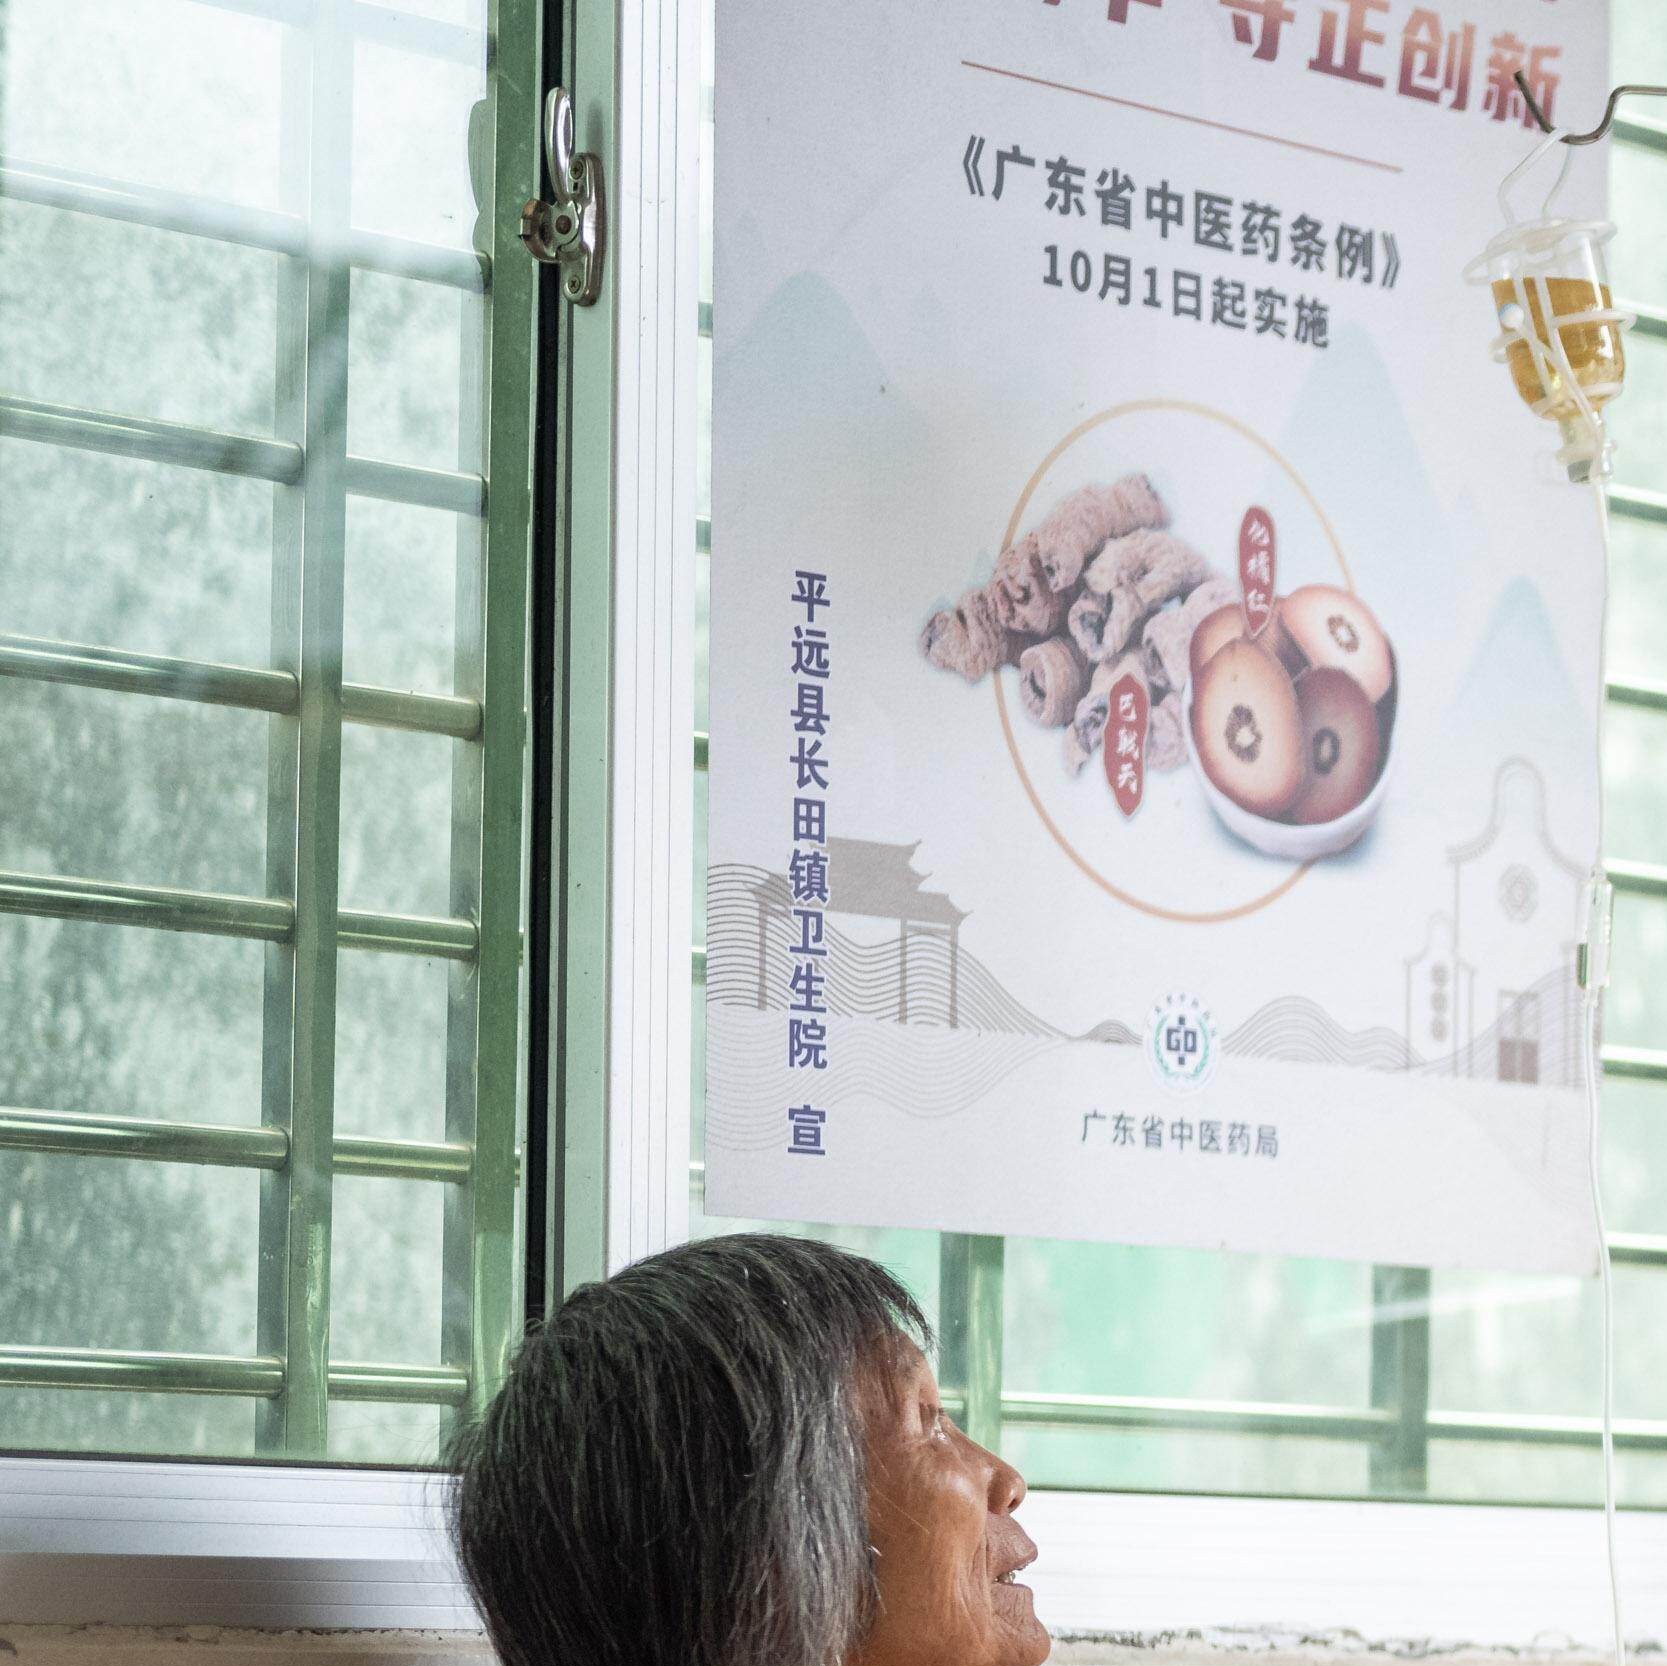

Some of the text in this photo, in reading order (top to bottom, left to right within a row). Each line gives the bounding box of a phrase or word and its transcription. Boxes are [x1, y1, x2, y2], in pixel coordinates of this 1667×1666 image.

[961, 134, 1402, 290] 《广东省中医药条例》
[1041, 243, 1330, 349] 10月1日起实施
[786, 571, 832, 1157] 平远县长田镇卫生院 宣
[1081, 1108, 1280, 1158] 广东省中医药局
